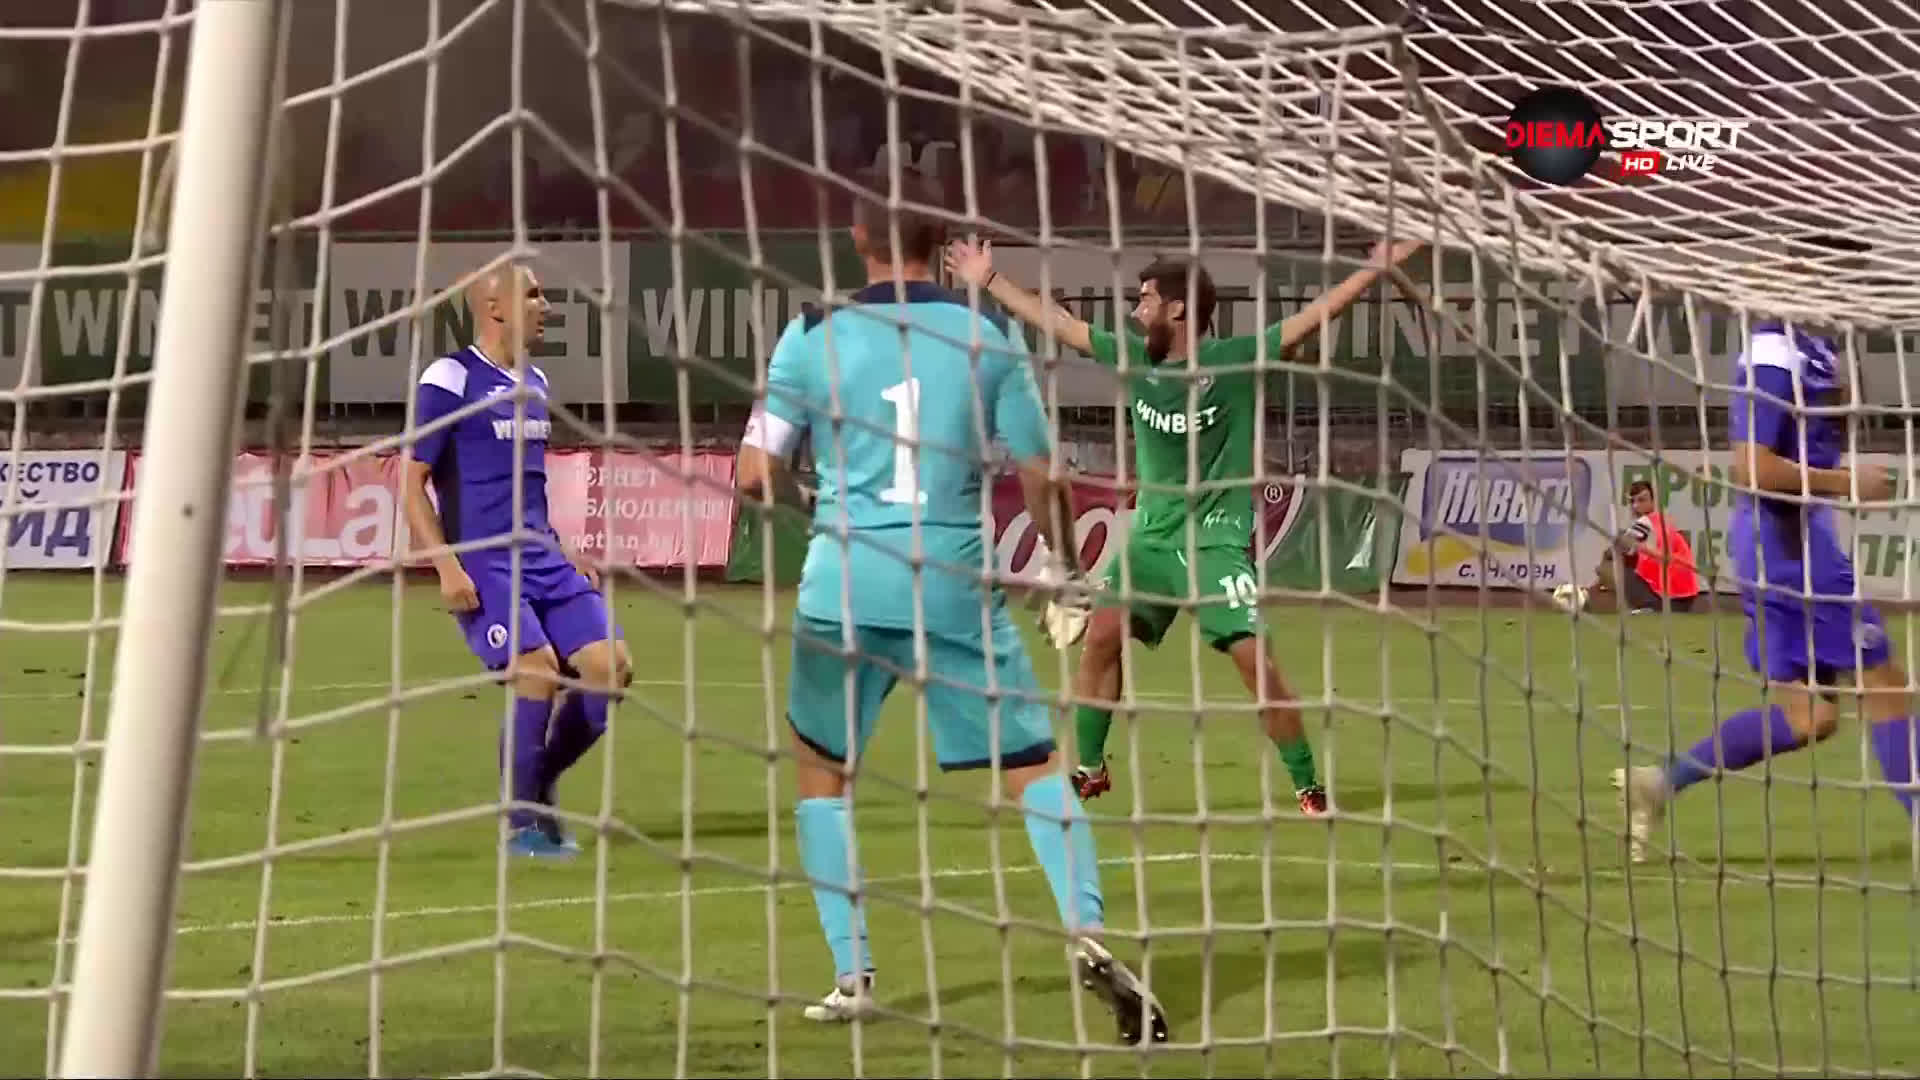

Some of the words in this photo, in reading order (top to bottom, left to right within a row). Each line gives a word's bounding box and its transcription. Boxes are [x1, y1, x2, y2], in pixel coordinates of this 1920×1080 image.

[344, 288, 617, 357] WINET
[880, 377, 928, 504] 1
[1136, 399, 1218, 434] WINBET
[1218, 572, 1257, 609] 10
